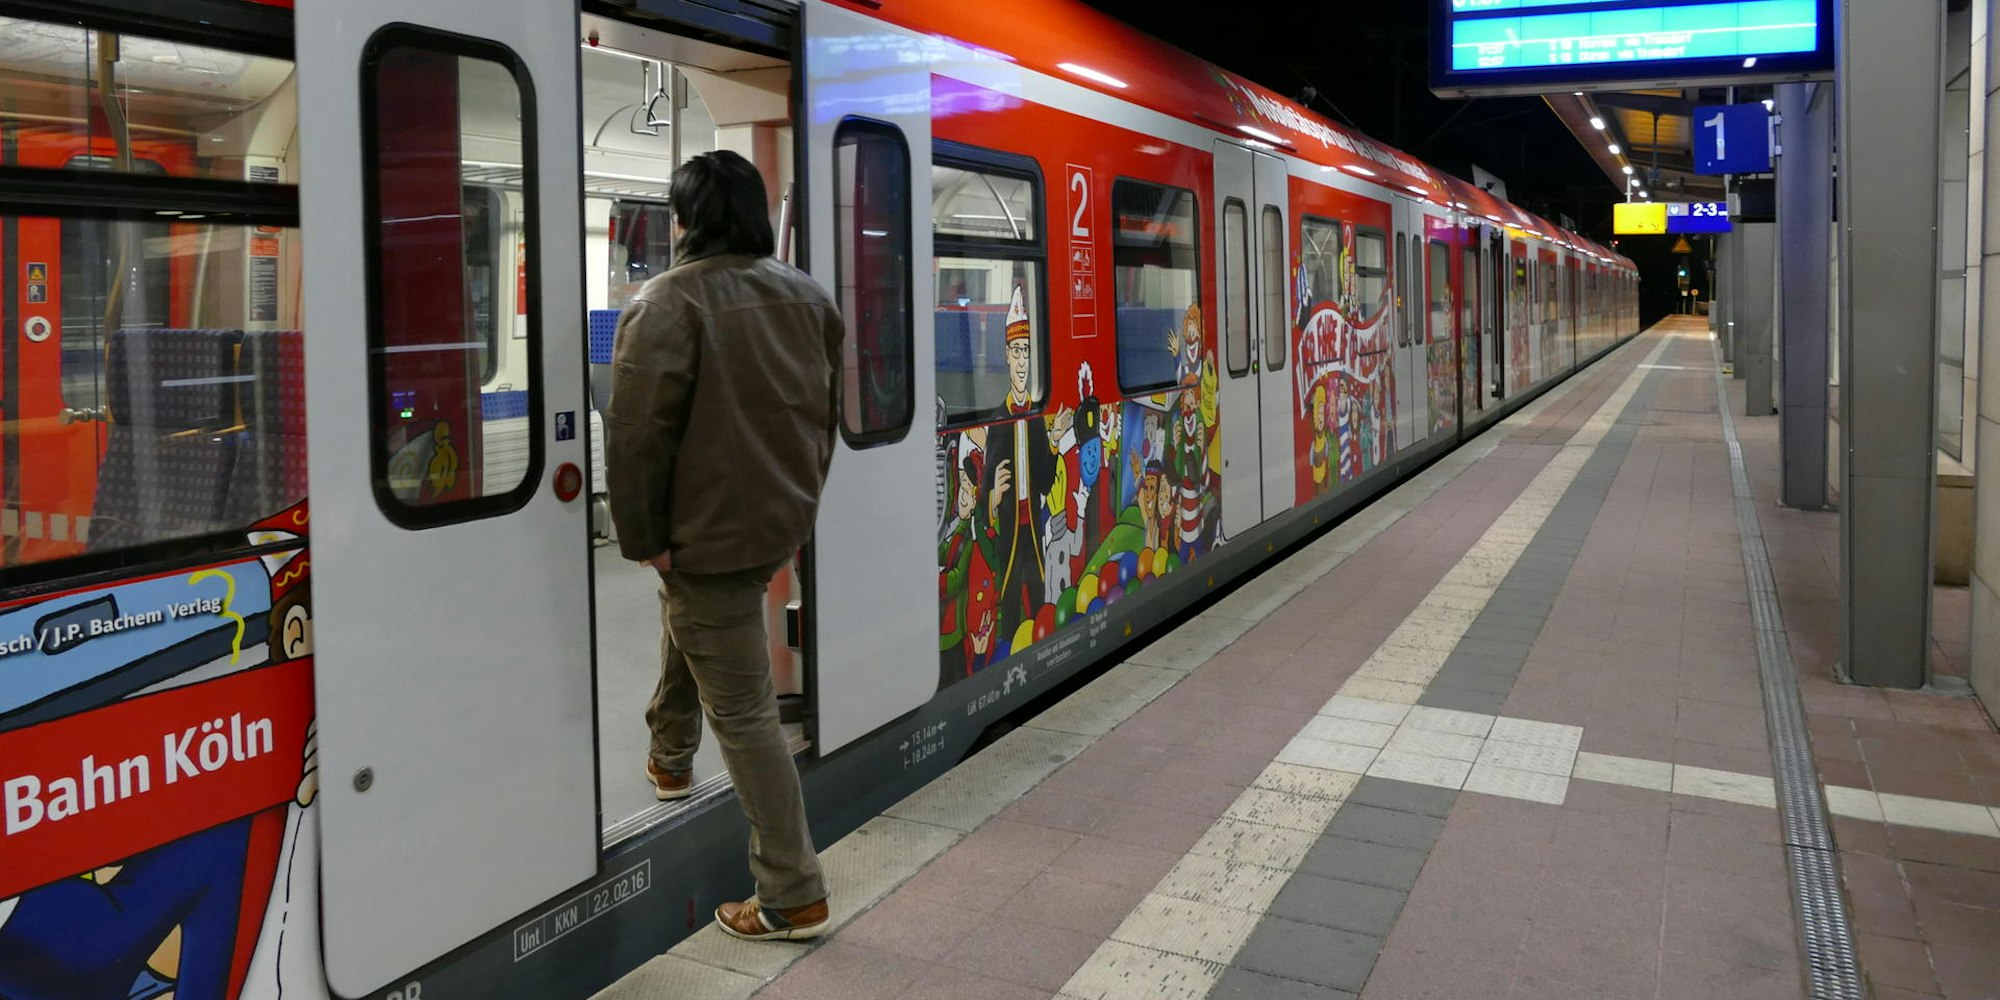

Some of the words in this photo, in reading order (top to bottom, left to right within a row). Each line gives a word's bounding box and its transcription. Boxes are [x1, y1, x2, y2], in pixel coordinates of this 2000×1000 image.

[1704, 112, 1725, 160] 1
[1071, 172, 1089, 237] 2
[53, 624, 84, 648] J.P.
[90, 608, 162, 635] Bachem
[167, 597, 222, 618] Verlag
[4, 755, 150, 836] Bahn
[164, 712, 273, 784] Köln
[593, 870, 644, 914] 22.02.16
[520, 927, 540, 953] Unt
[555, 905, 578, 934] KKN
